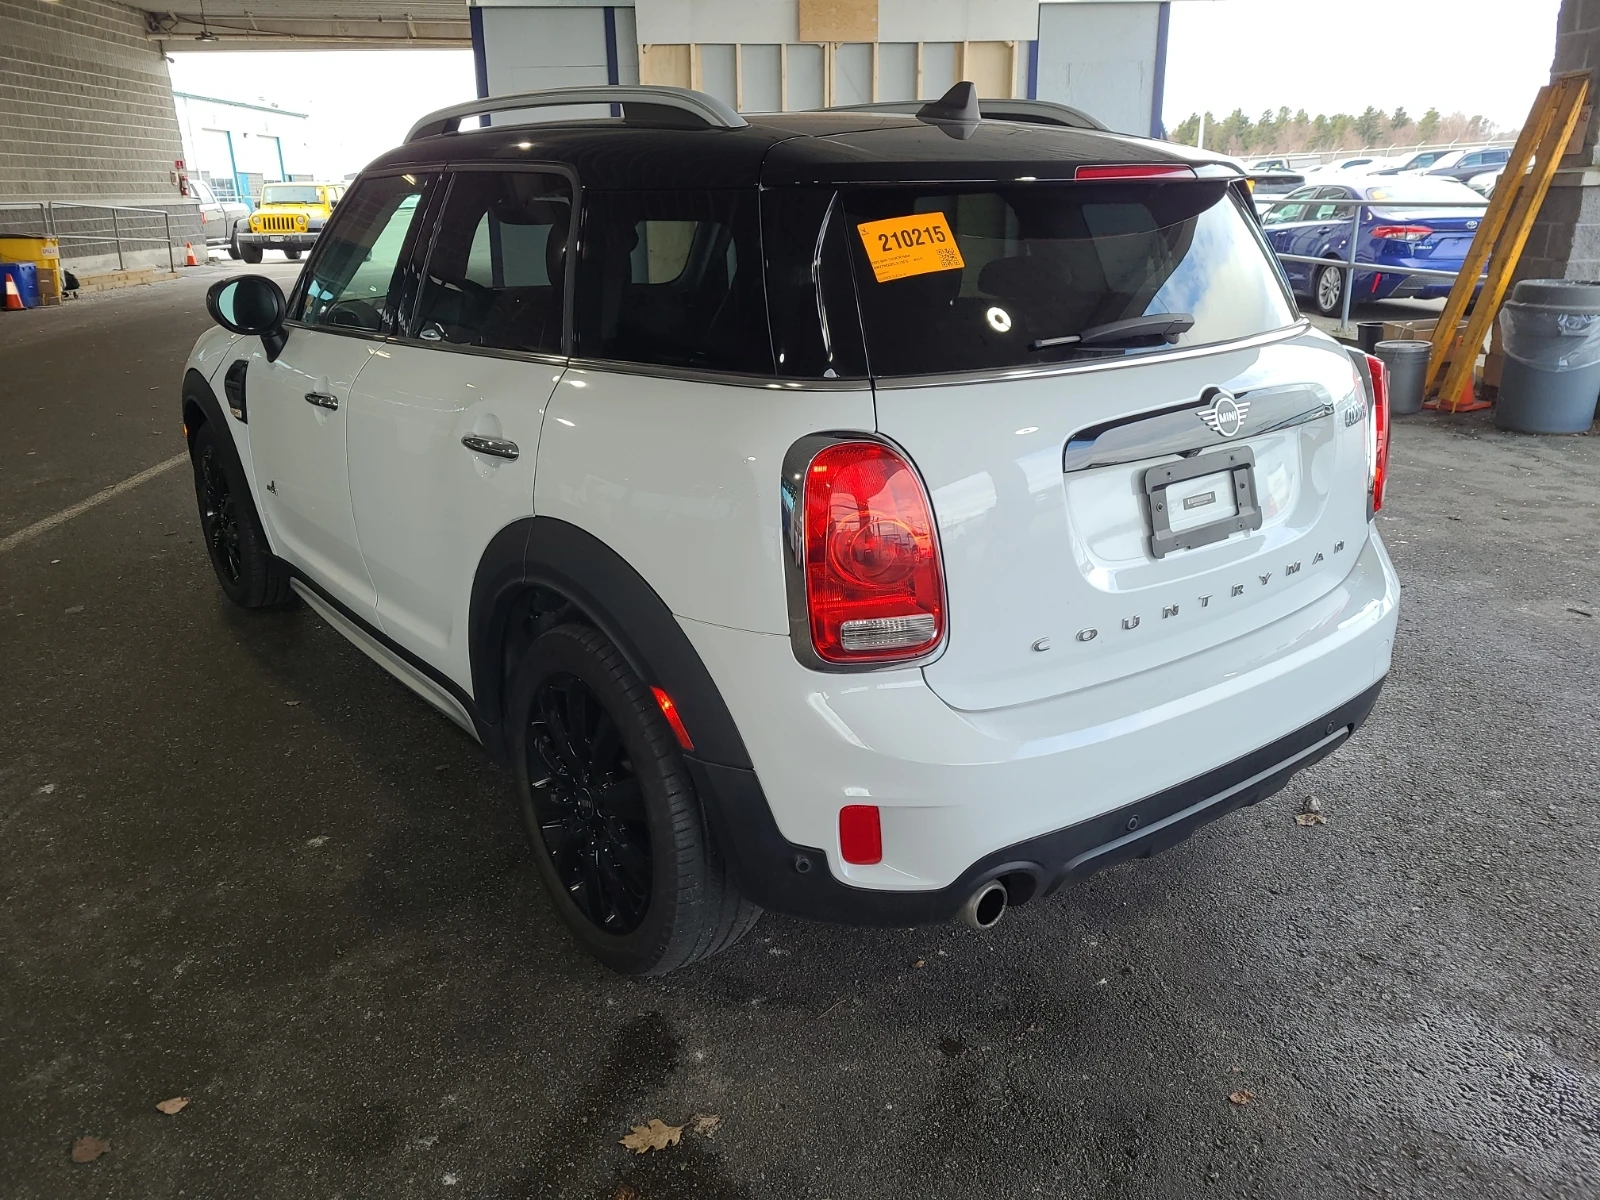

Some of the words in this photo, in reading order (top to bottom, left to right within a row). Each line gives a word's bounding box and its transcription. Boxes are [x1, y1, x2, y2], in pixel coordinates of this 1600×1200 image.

[878, 225, 946, 252] 210215
[1219, 410, 1237, 424] MINI
[1031, 539, 1345, 653] COUNTRYMAN
